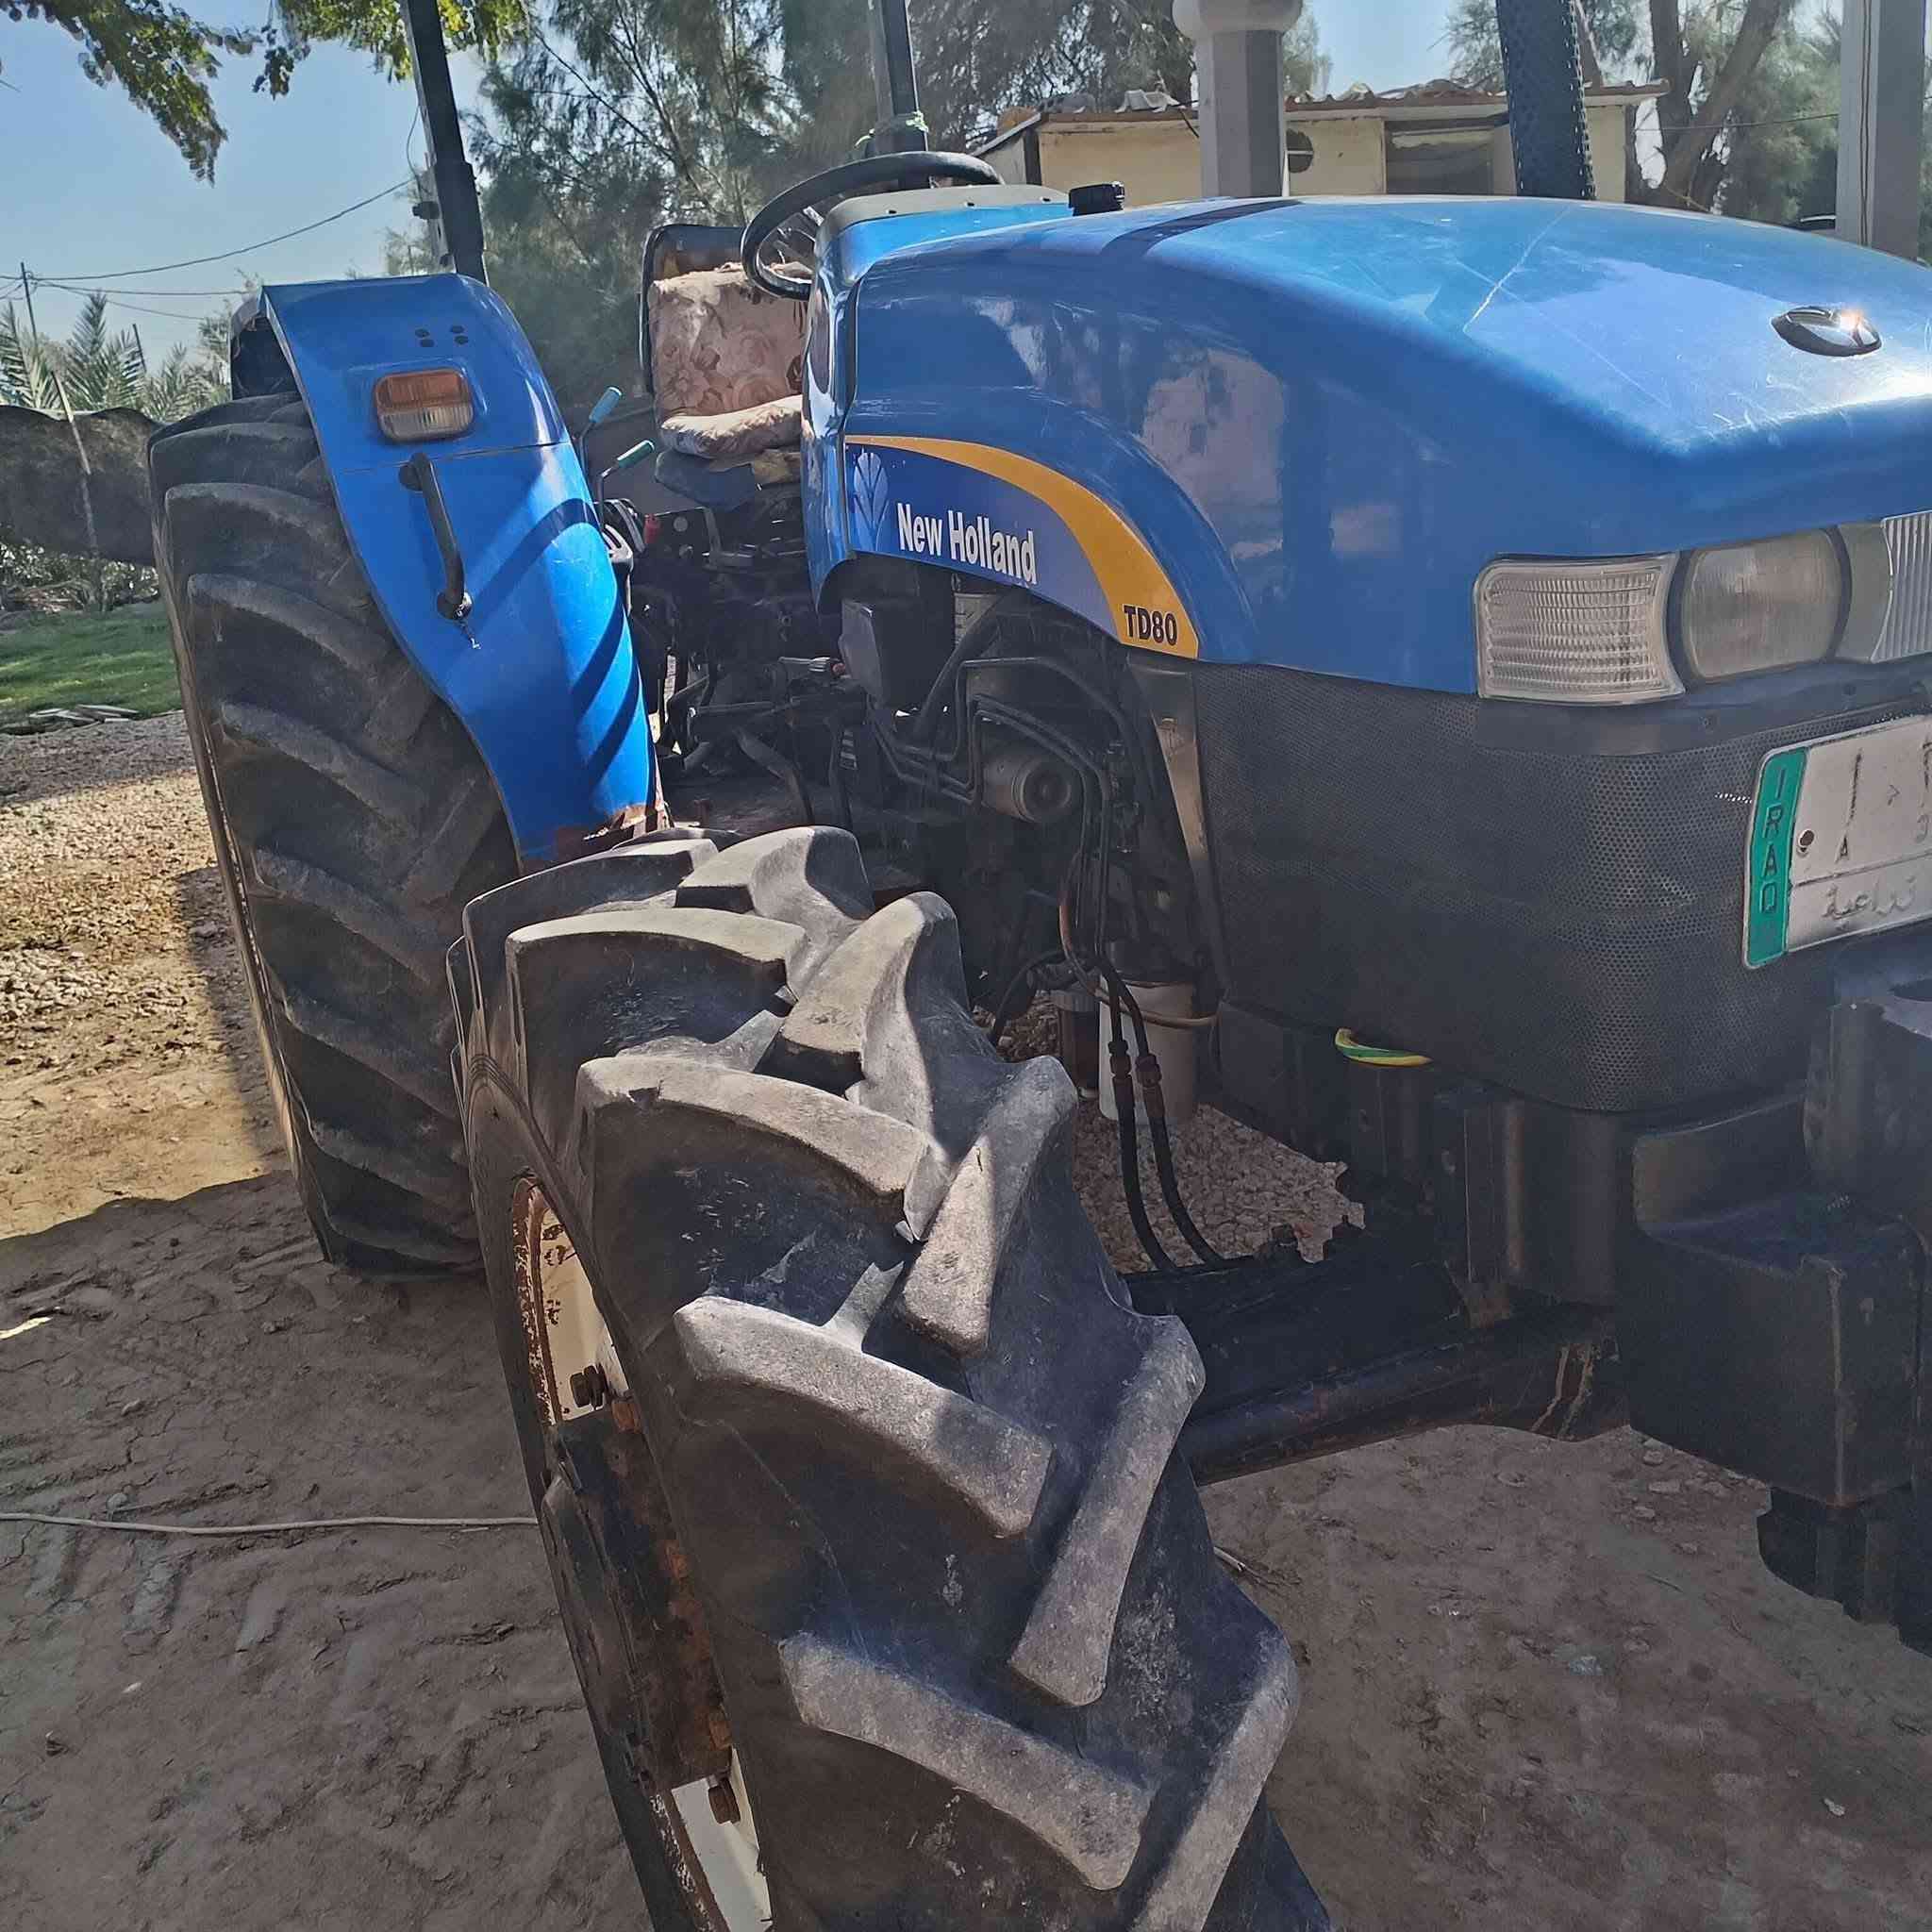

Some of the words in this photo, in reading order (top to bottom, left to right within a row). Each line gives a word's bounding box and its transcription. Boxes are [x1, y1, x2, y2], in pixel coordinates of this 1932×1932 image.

[896, 502, 942, 557] New
[947, 509, 1038, 585] Holland
[1123, 604, 1178, 646] TD80
[1758, 768, 1787, 915] IRAQ
